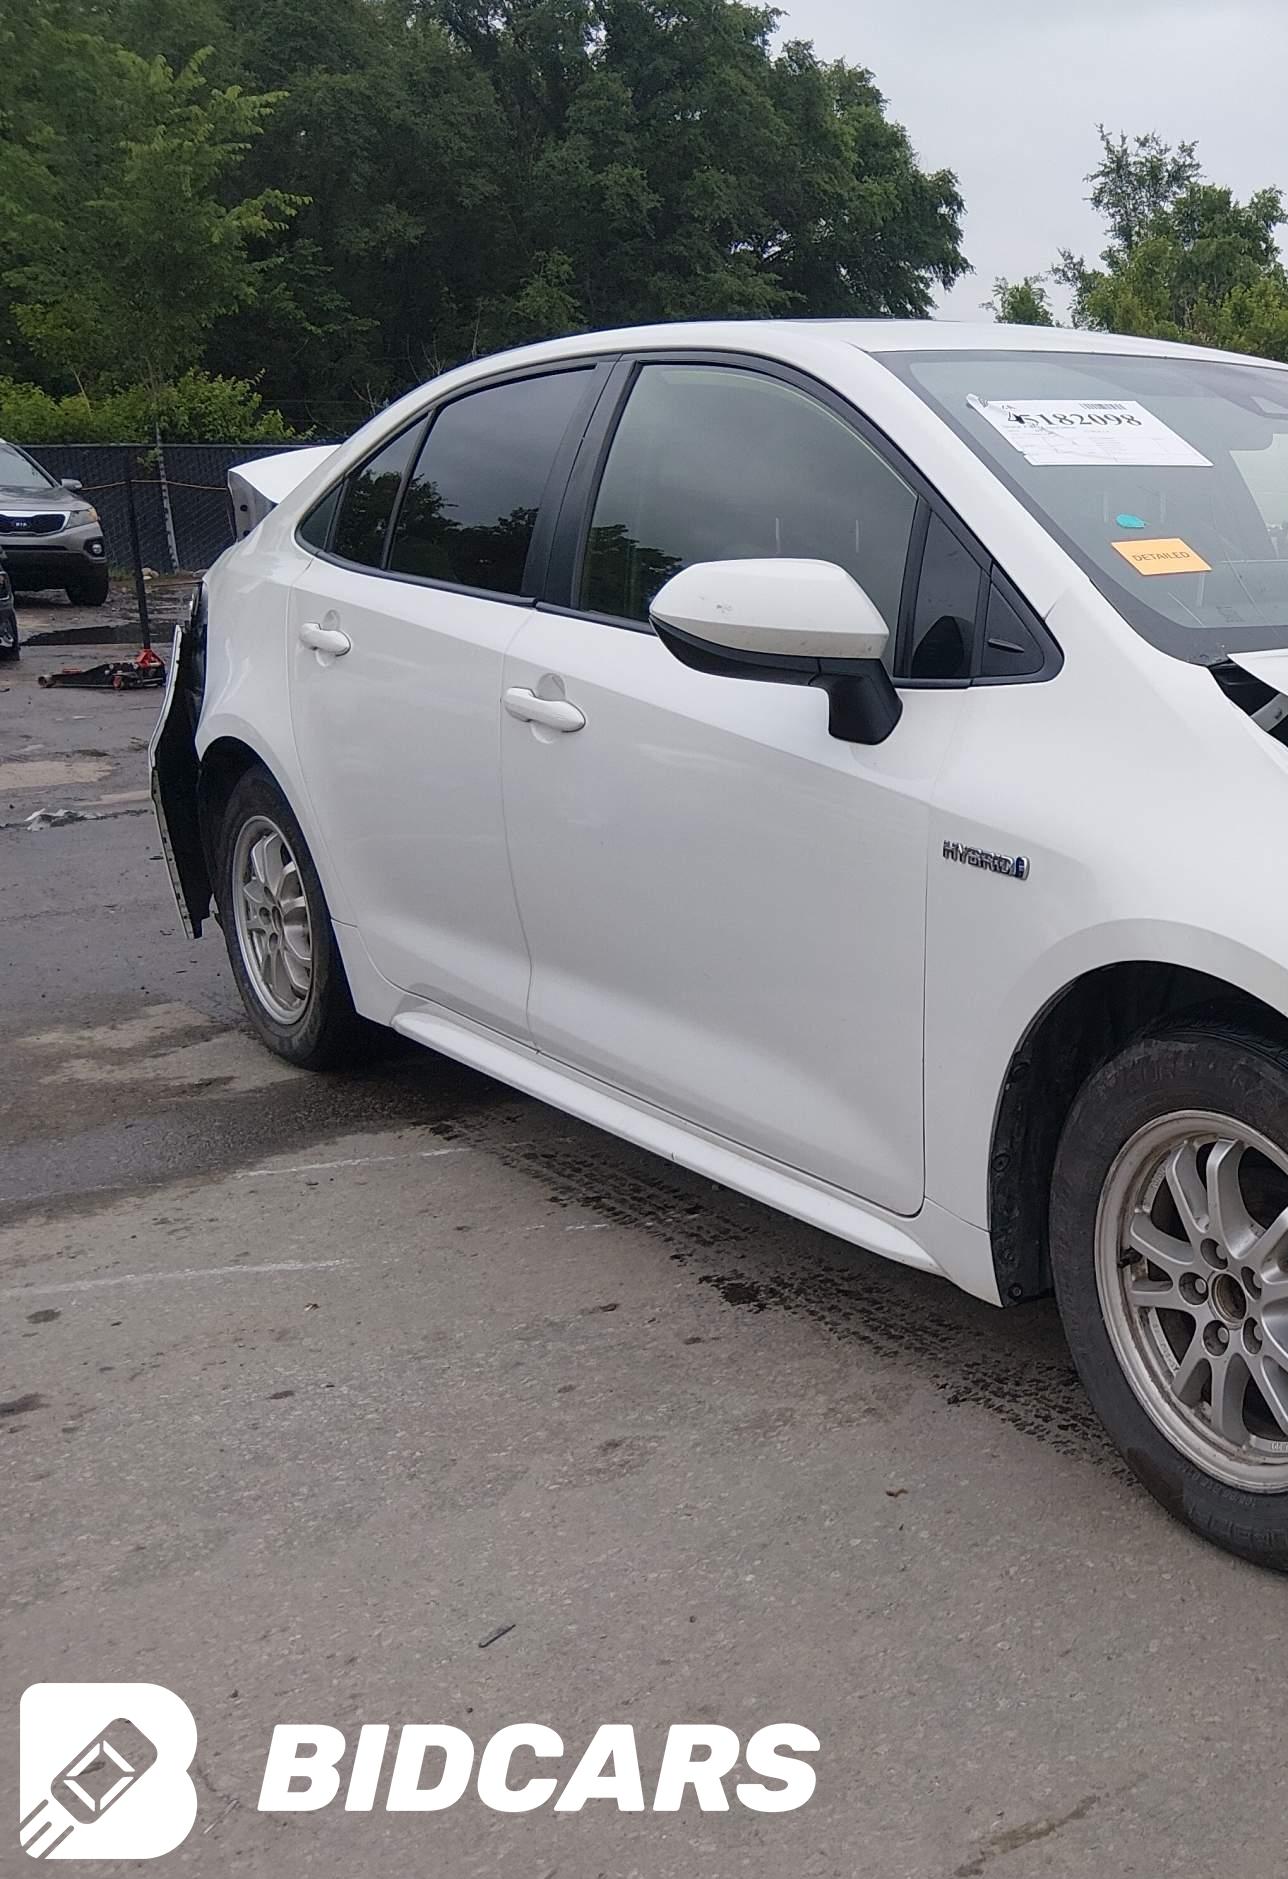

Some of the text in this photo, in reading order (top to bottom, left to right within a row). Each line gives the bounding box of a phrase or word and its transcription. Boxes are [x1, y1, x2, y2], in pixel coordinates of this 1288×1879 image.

[1008, 411, 1142, 426] 45182098
[1132, 551, 1190, 562] DETAILED
[942, 840, 1014, 876] HYBRID
